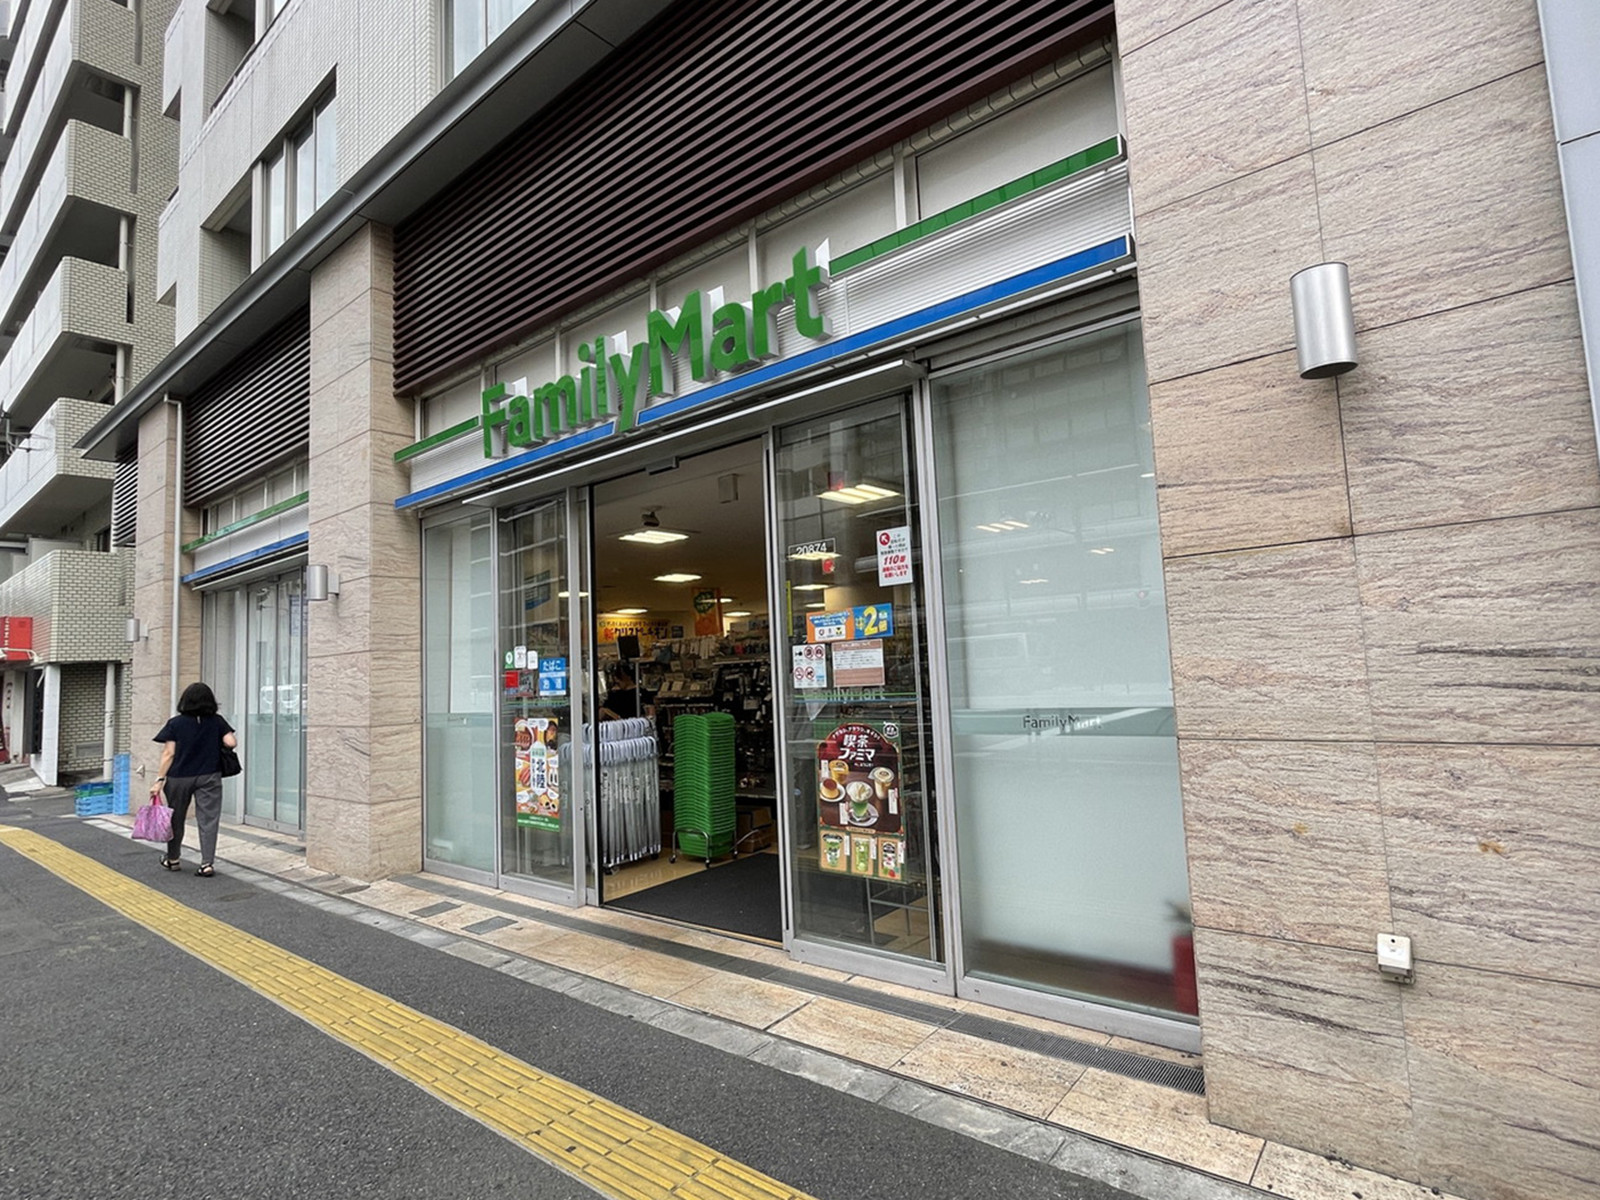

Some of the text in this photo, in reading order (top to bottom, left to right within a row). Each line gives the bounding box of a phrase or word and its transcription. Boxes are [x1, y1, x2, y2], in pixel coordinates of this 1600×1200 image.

[482, 246, 833, 459] FamilyMart
[838, 748, 876, 761] ファミマ
